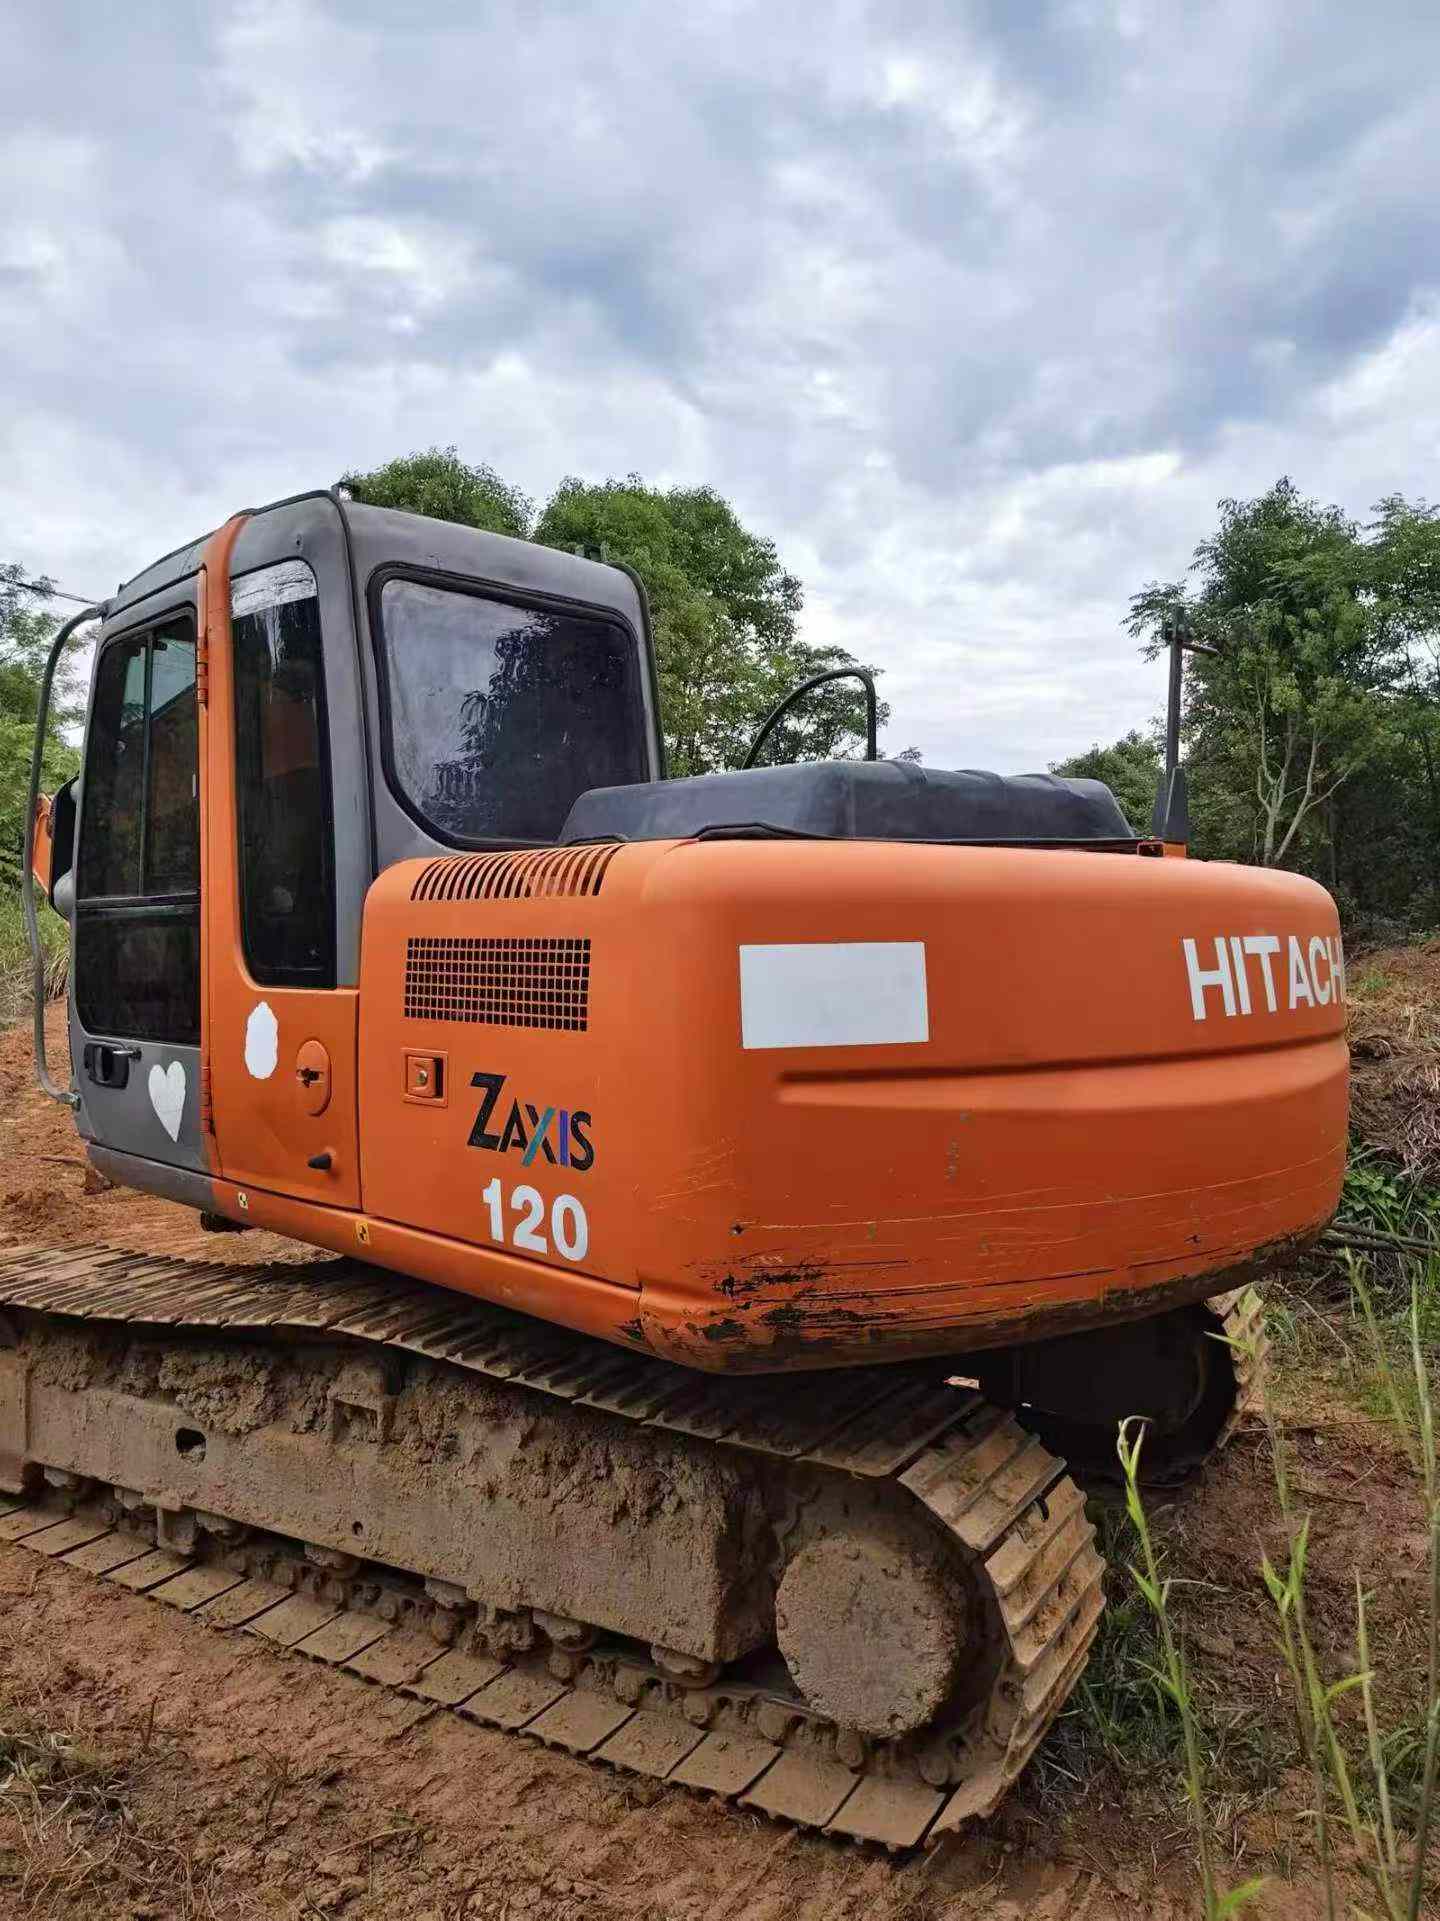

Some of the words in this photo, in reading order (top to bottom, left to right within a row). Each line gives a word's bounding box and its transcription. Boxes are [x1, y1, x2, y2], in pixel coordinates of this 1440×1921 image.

[1183, 935, 1345, 1020] HITACH
[467, 1072, 595, 1171] ZAXIS
[482, 1177, 588, 1261] 120
